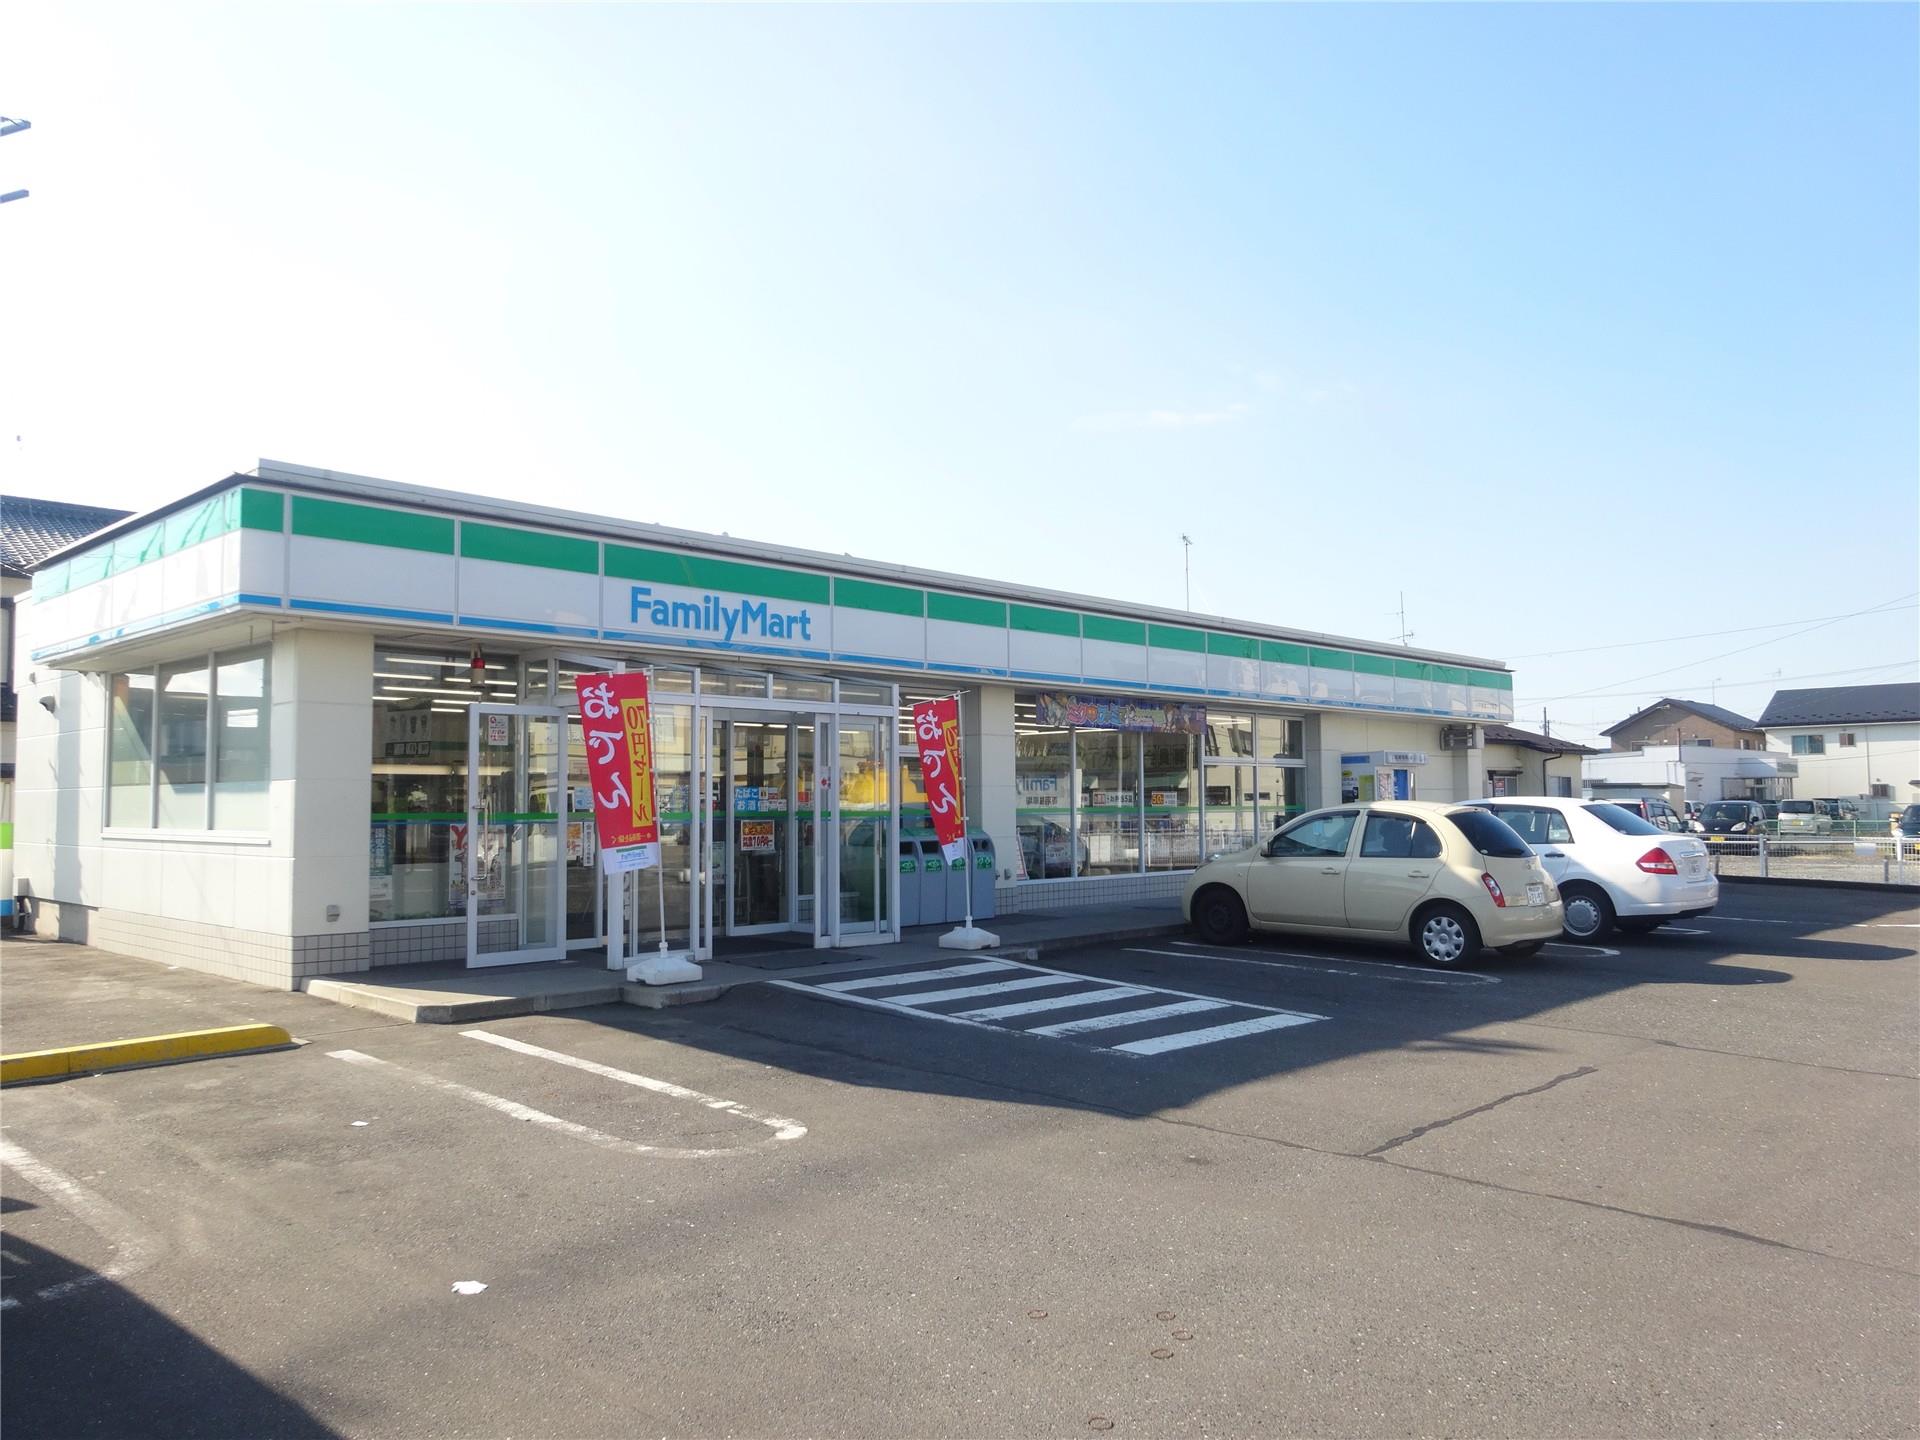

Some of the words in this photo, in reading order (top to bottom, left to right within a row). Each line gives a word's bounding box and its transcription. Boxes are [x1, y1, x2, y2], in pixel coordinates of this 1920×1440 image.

[631, 586, 811, 641] FamilyMart
[735, 788, 758, 799] たばこ
